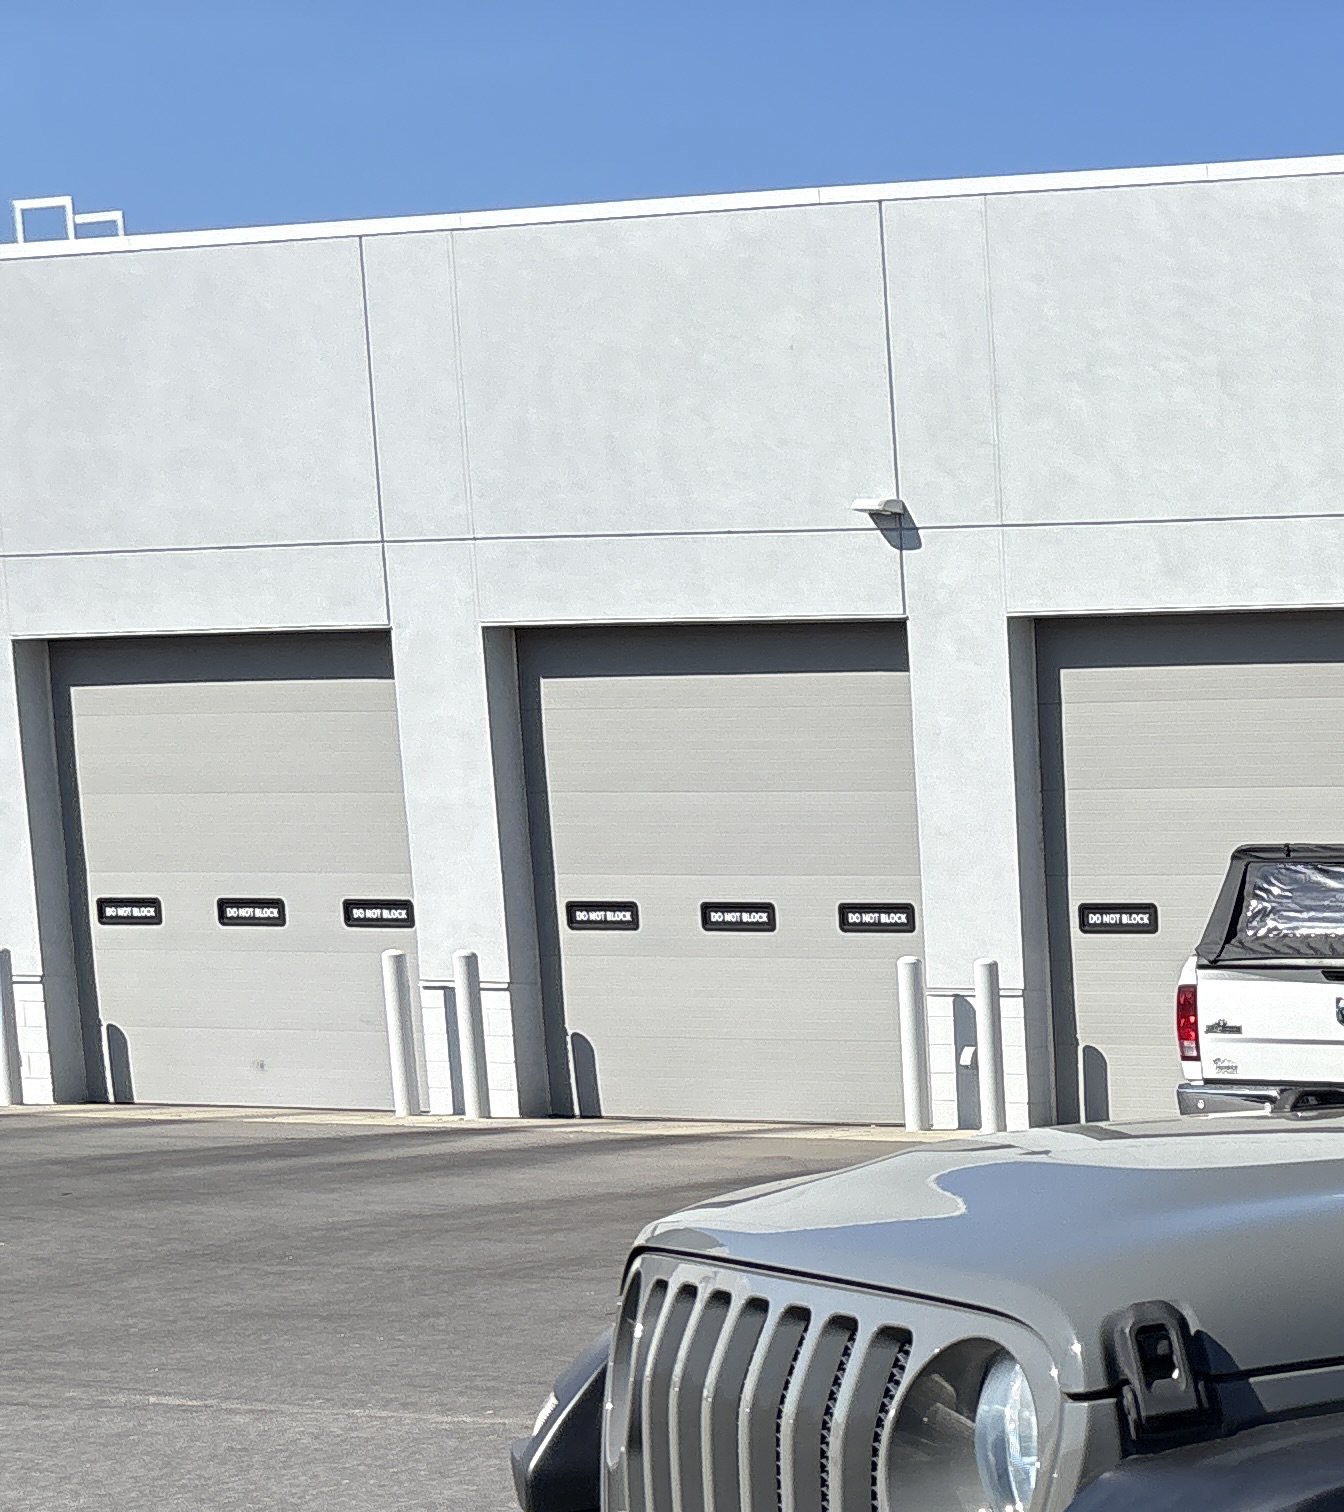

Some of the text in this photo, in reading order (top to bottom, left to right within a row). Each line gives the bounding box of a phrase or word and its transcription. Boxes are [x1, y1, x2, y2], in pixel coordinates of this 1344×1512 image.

[106, 907, 155, 917] DO NOT BLOCK
[226, 908, 279, 917] DO NOT BLOCK
[352, 909, 407, 918] DO NOT BLOCK
[576, 911, 632, 921] DO NOT BLOCK
[711, 912, 768, 922] DO NOT BLOCK
[848, 913, 907, 923] DO NOT BLOCK
[1089, 914, 1149, 924] DO NOT BLOCK
